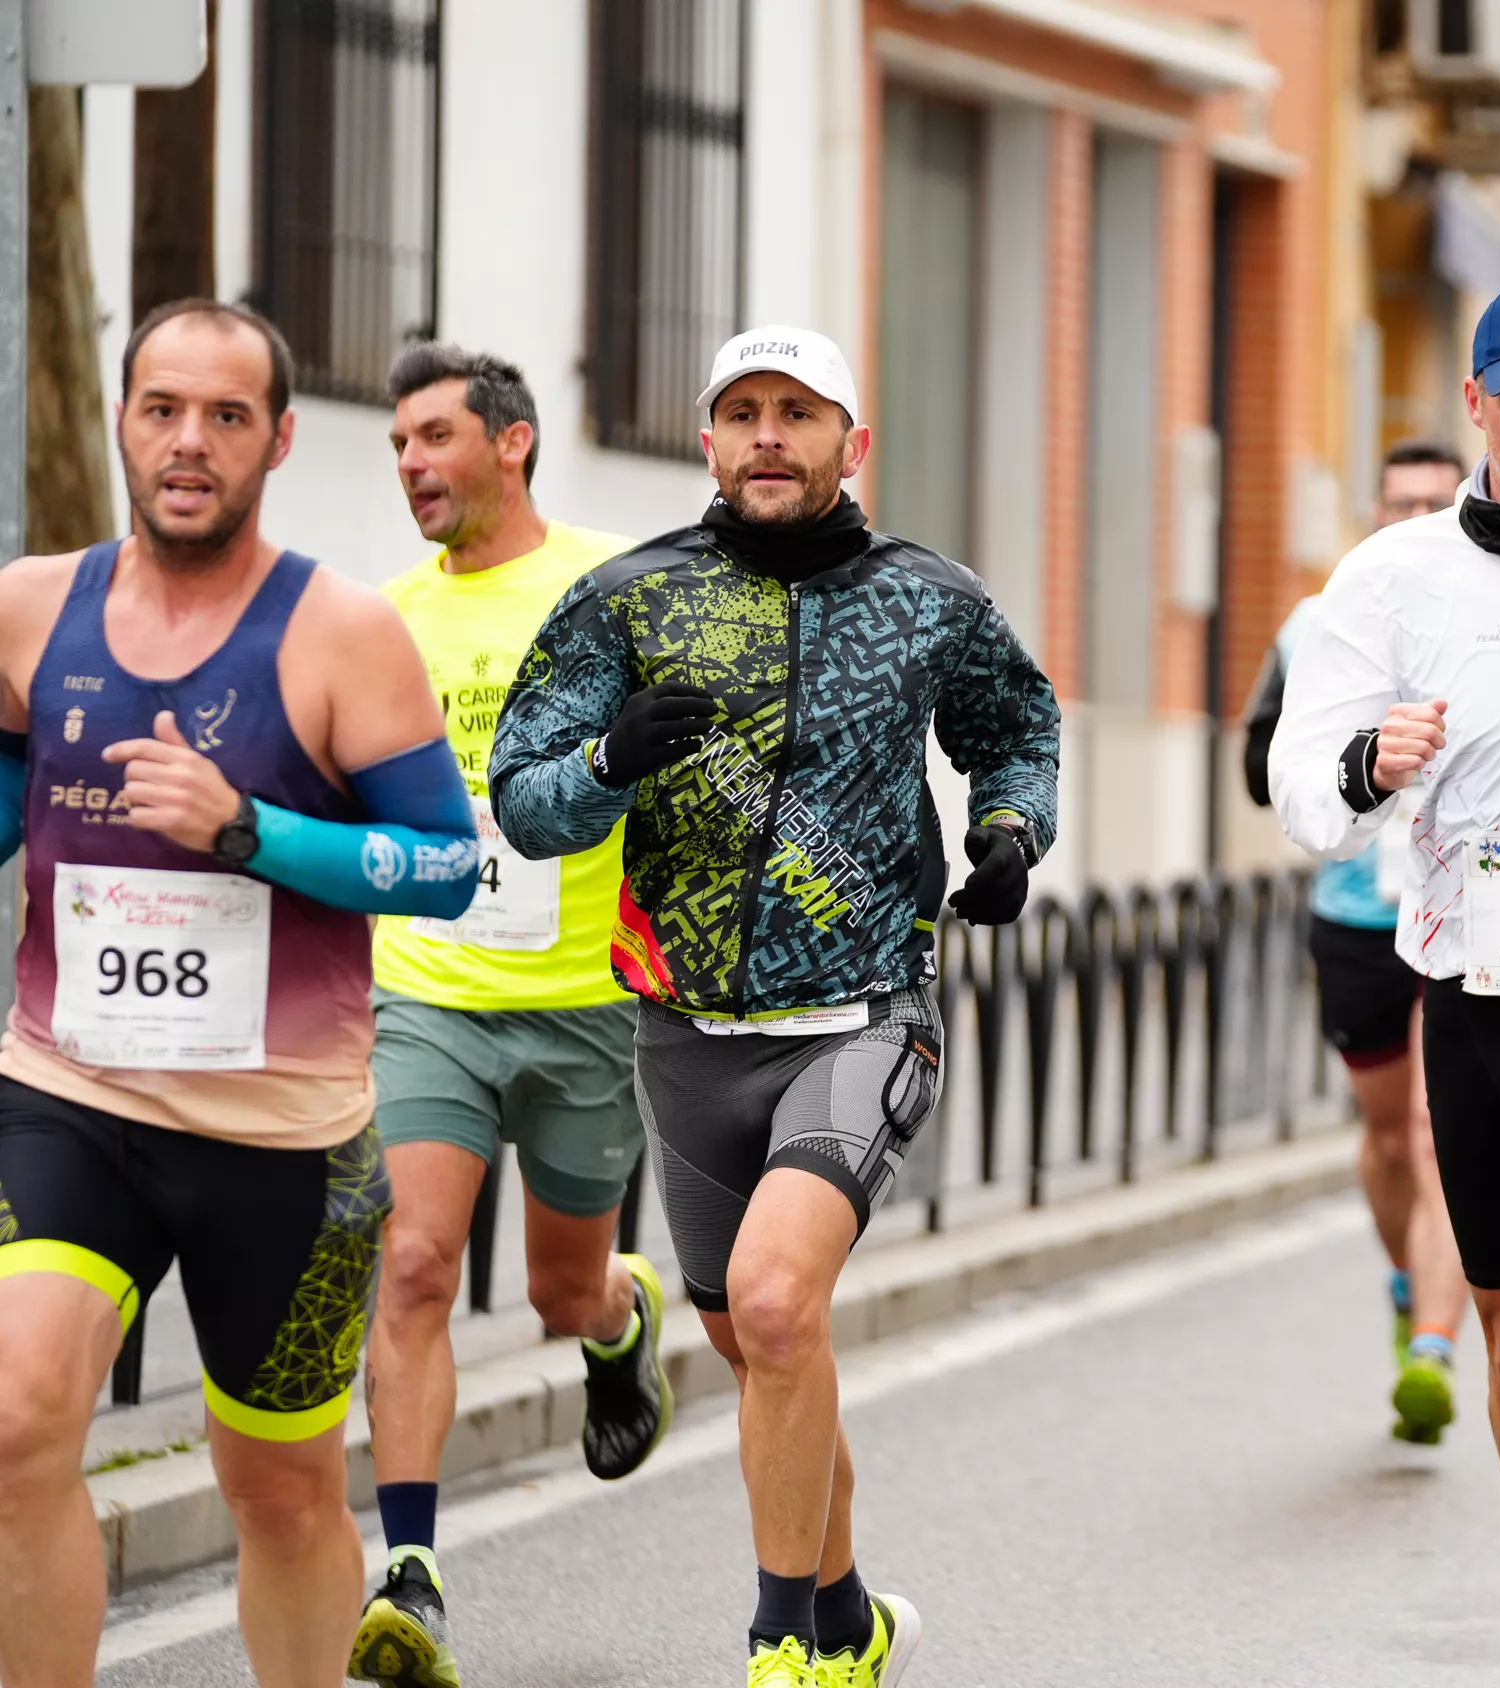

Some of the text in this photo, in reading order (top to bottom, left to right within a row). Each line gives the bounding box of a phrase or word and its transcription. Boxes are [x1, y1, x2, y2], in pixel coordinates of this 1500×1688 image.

[457, 687, 510, 706] CARR
[765, 838, 850, 933] TRAIL
[98, 947, 208, 997] 968
[914, 1039, 937, 1066] WONG
